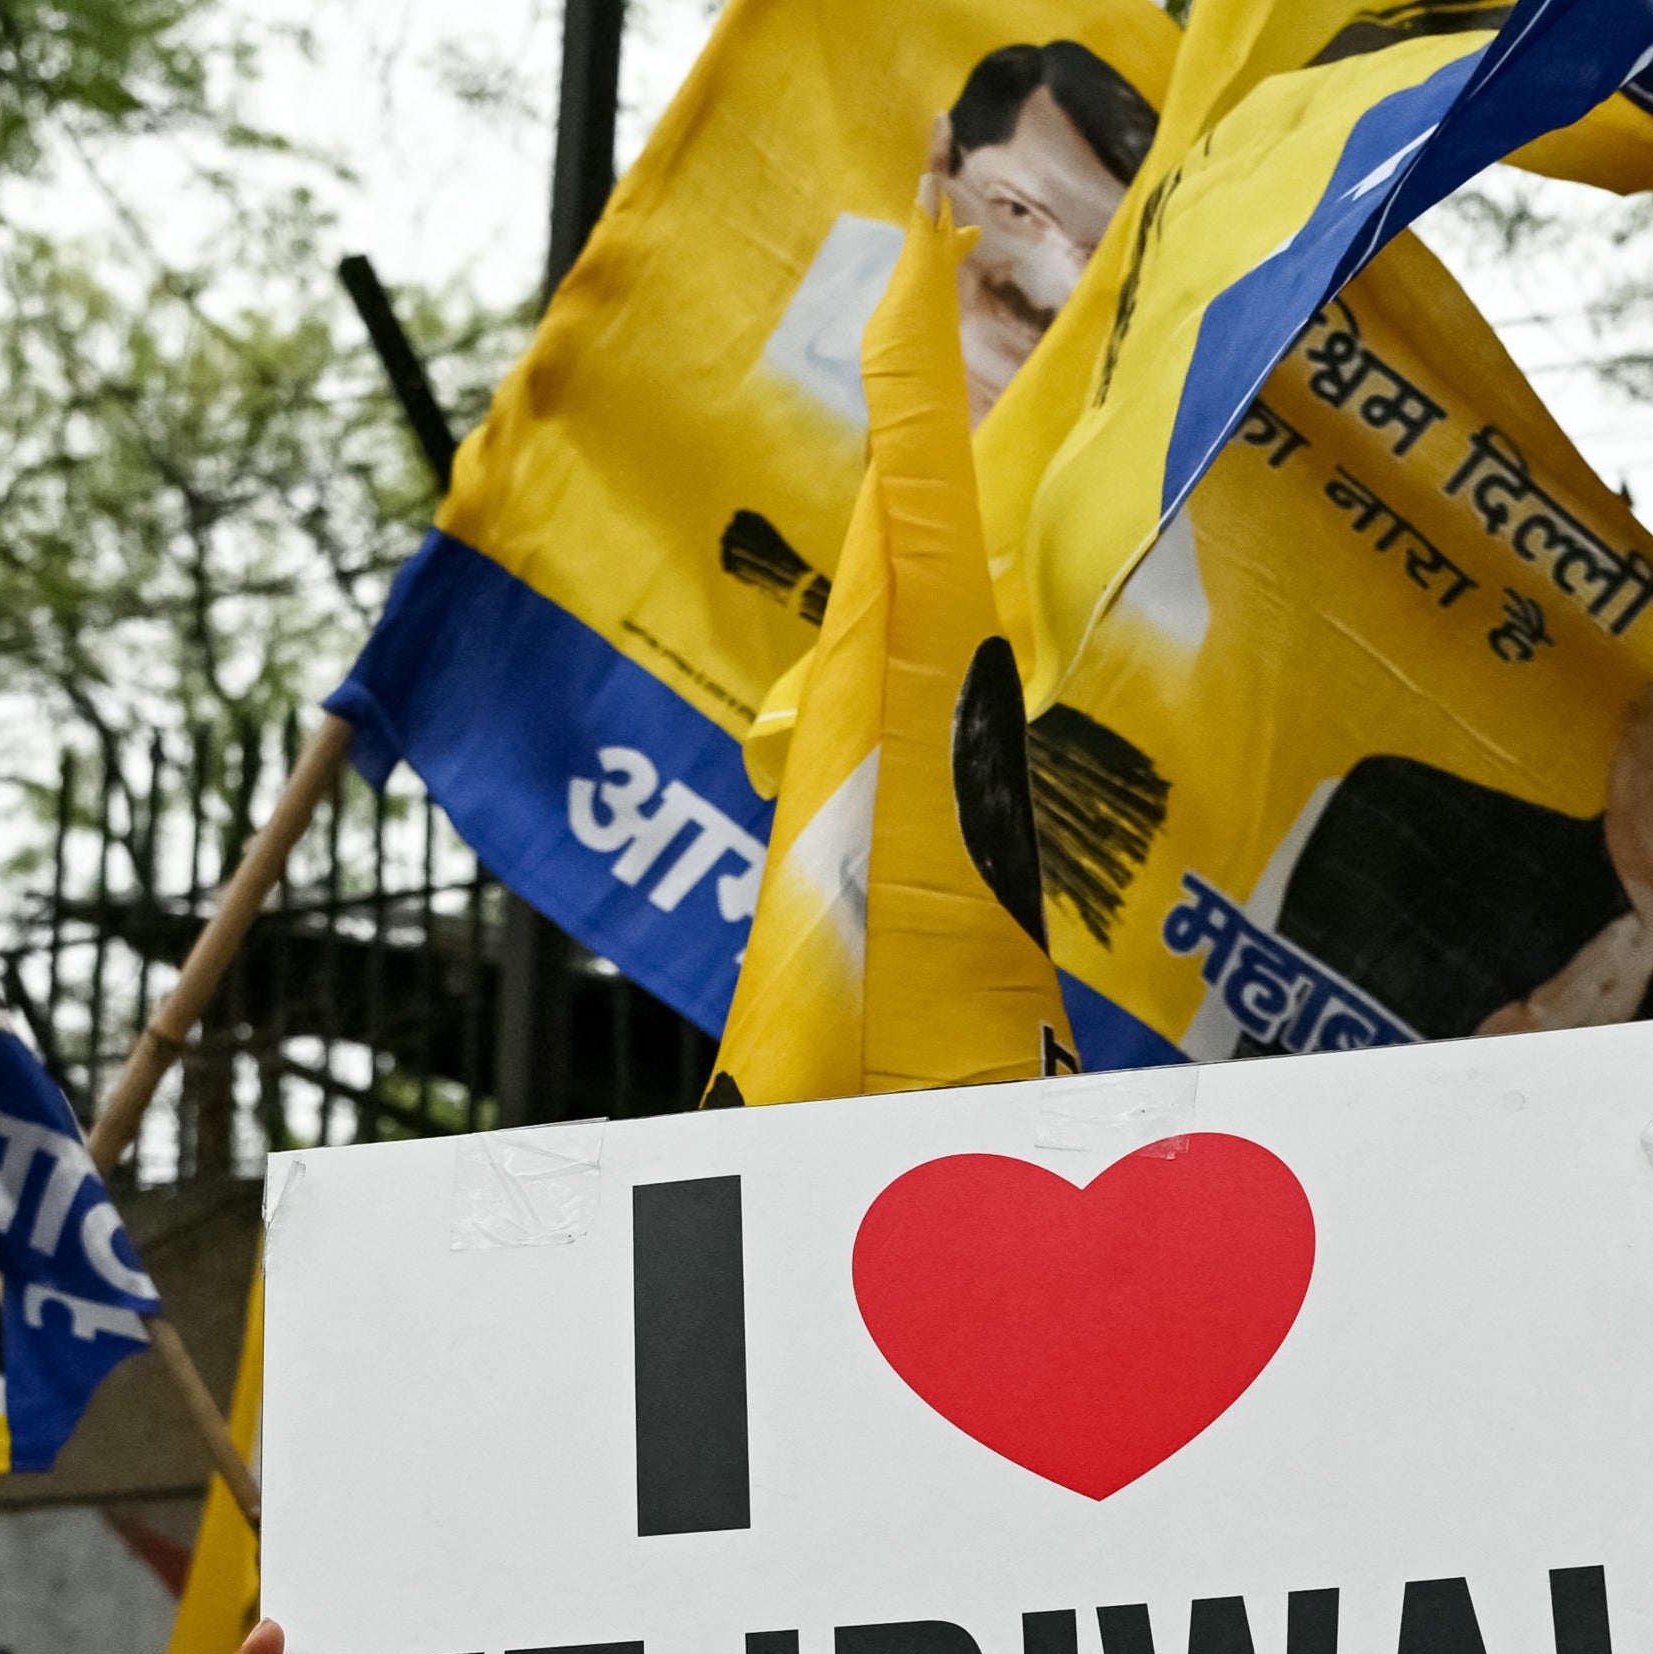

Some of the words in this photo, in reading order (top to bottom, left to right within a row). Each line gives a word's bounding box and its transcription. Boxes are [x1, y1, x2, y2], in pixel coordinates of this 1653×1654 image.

[1323, 463, 1480, 609] नारा
[1487, 584, 1555, 663] है
[632, 1174, 751, 1537] I
